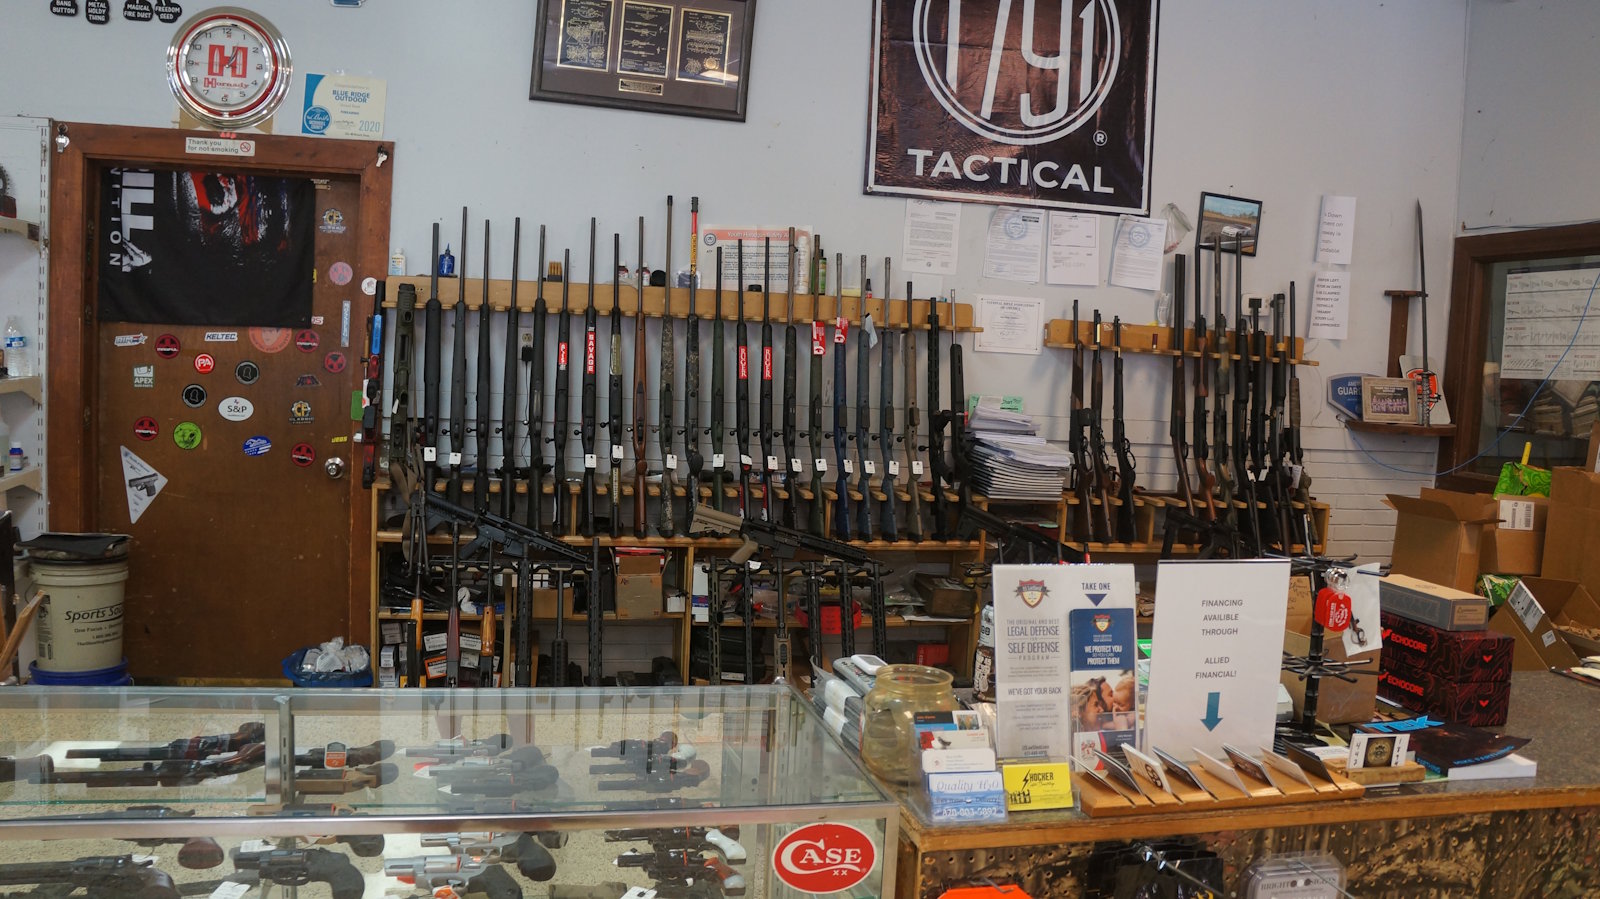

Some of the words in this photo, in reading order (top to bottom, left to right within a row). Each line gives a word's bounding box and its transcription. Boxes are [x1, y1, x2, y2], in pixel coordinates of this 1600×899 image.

[203, 77, 249, 89] Hornady
[335, 95, 368, 103] OUTDOOR
[359, 120, 381, 132] 2020
[907, 149, 1115, 194] TACTICAL
[227, 405, 248, 413] S&P
[1201, 599, 1243, 607] FINANCING
[65, 609, 106, 623] Sports
[1007, 626, 1028, 636] LEGAL
[1030, 626, 1060, 636] DEFENSE
[1008, 642, 1026, 653] SELF
[1027, 642, 1060, 653] DEFENSE
[1391, 633, 1428, 653] ECHOCORE
[1204, 656, 1230, 664] ALLIED
[1195, 670, 1237, 679] FINANCIAL!
[1034, 687, 1048, 695] YOUR
[1387, 675, 1424, 697] ECHOCORE
[936, 780, 974, 793] Quality
[781, 839, 862, 874] CASE
